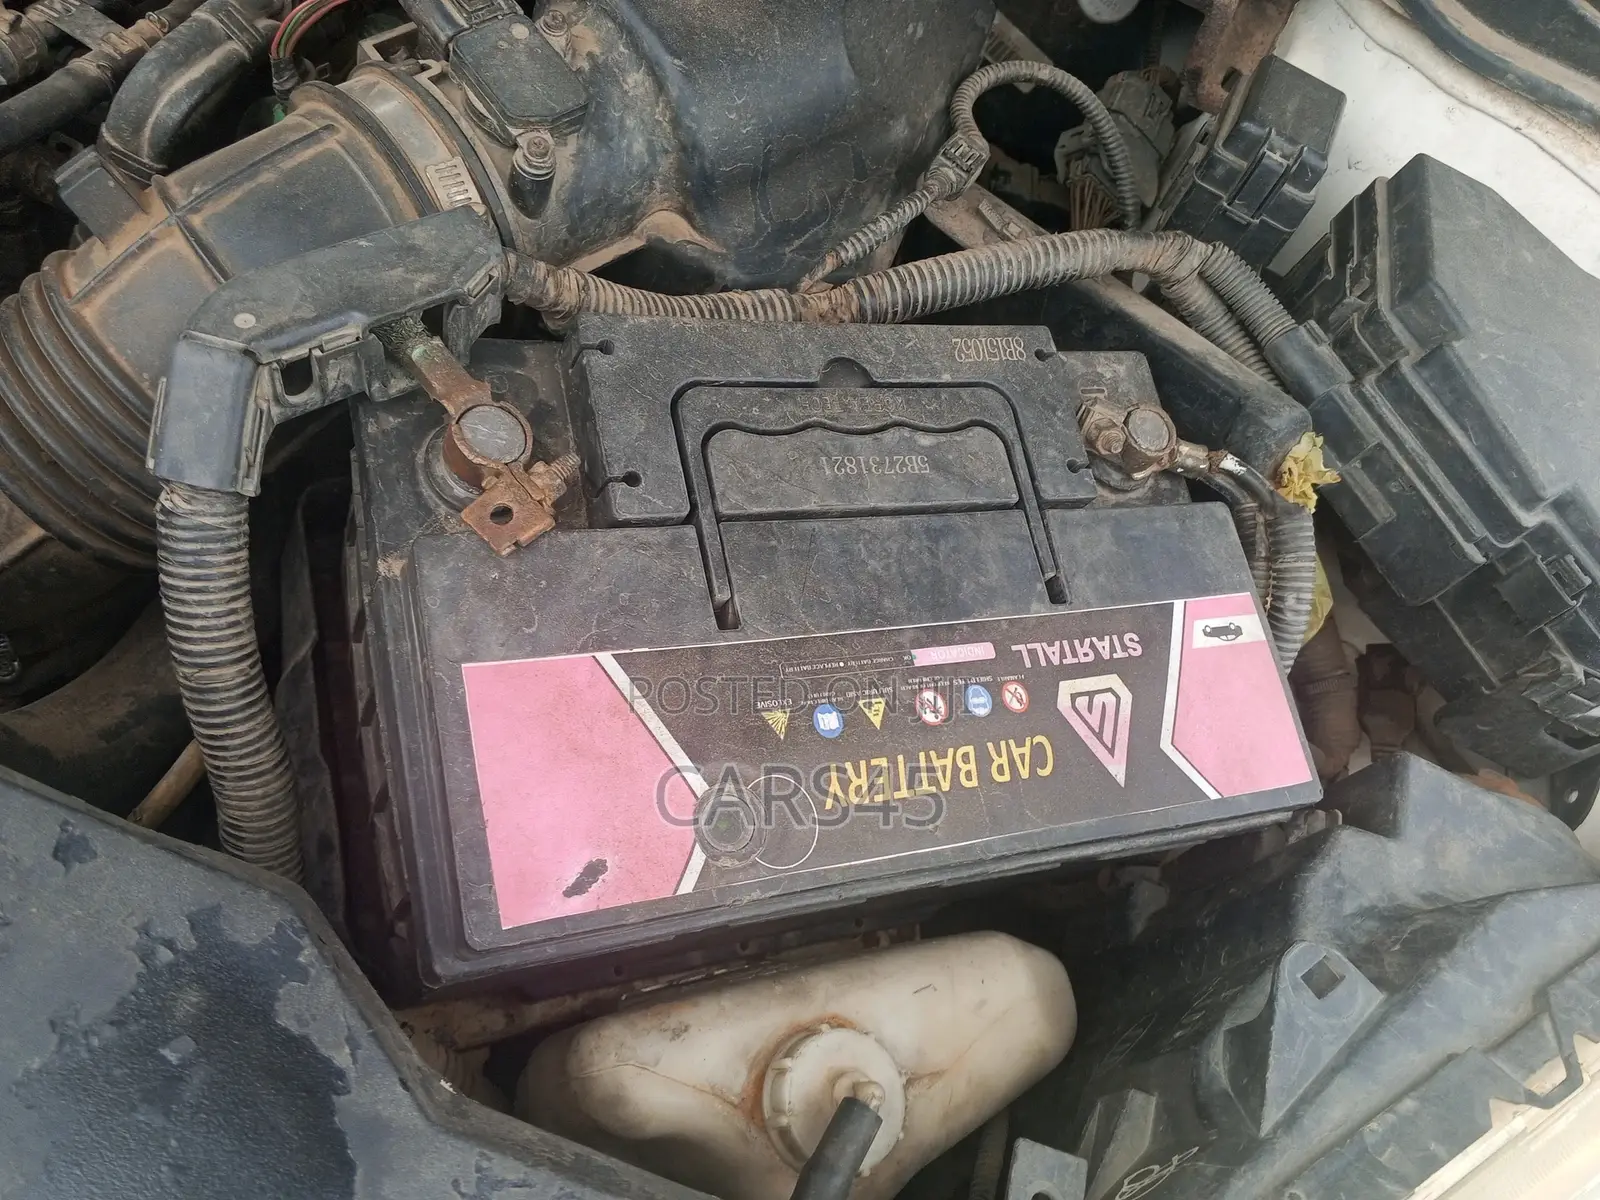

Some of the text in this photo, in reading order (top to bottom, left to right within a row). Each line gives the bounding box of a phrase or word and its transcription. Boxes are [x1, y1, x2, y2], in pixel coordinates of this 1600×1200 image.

[952, 336, 1026, 362] 8B151052
[820, 455, 930, 475] 5B2731821
[824, 734, 1054, 811] CAR BATTERY
